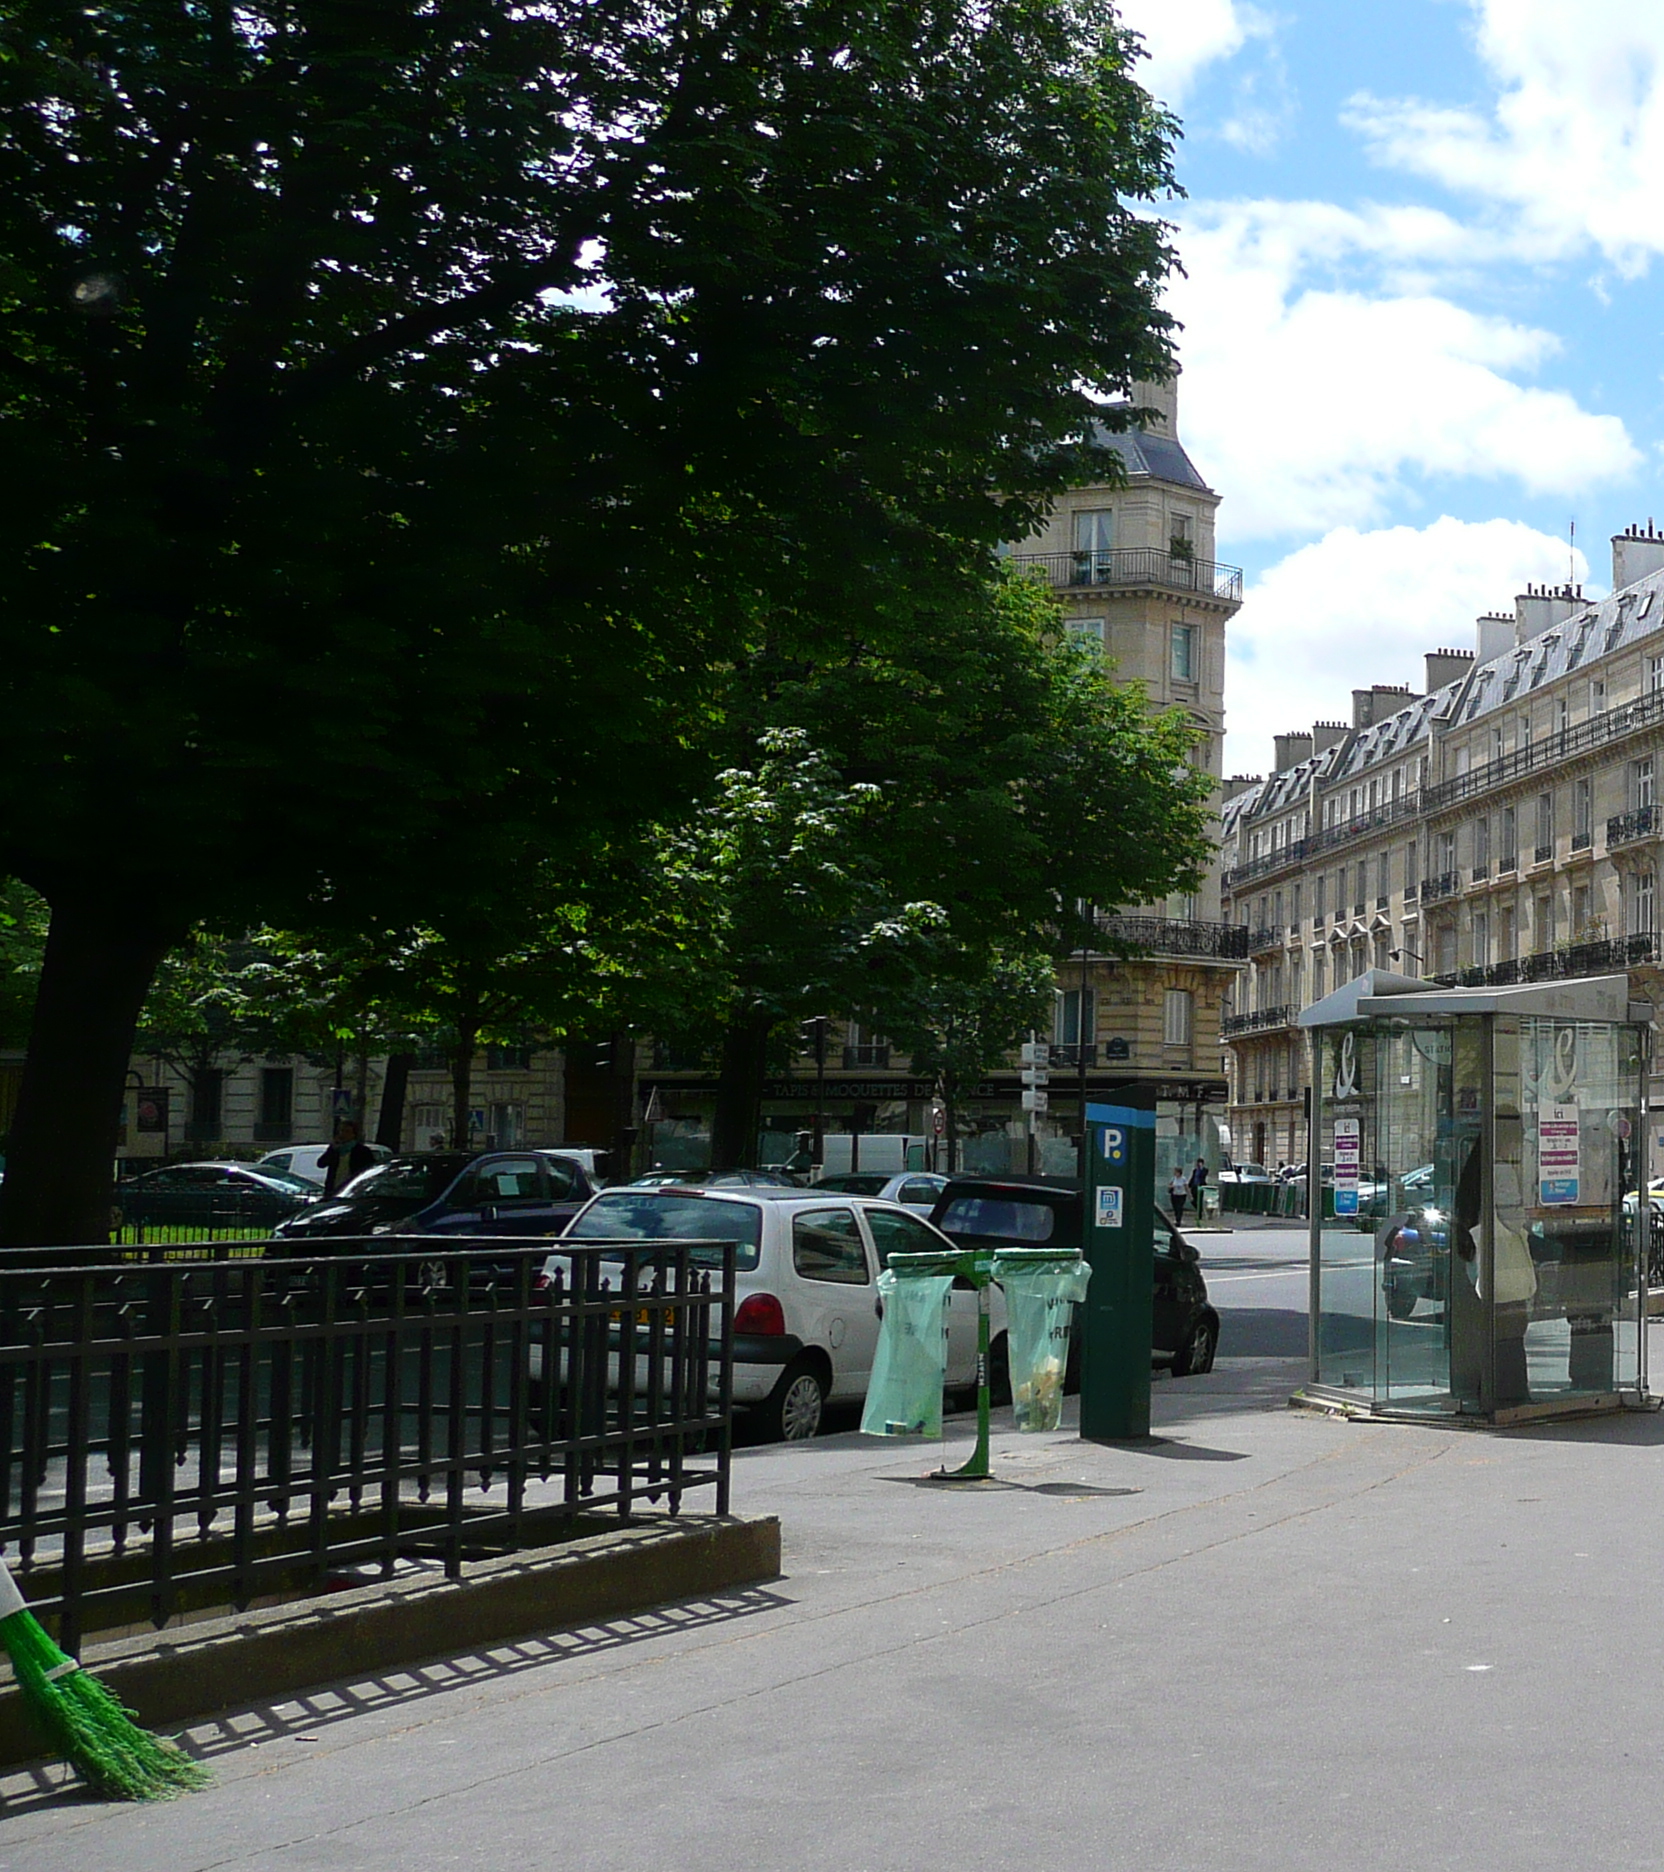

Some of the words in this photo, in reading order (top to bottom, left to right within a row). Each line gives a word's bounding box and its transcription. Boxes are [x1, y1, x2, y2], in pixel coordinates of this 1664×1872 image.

[773, 1083, 809, 1097] TAPIS
[825, 1083, 909, 1097] MOQUETTES
[913, 1083, 933, 1097] DE
[1104, 1128, 1122, 1158] P
